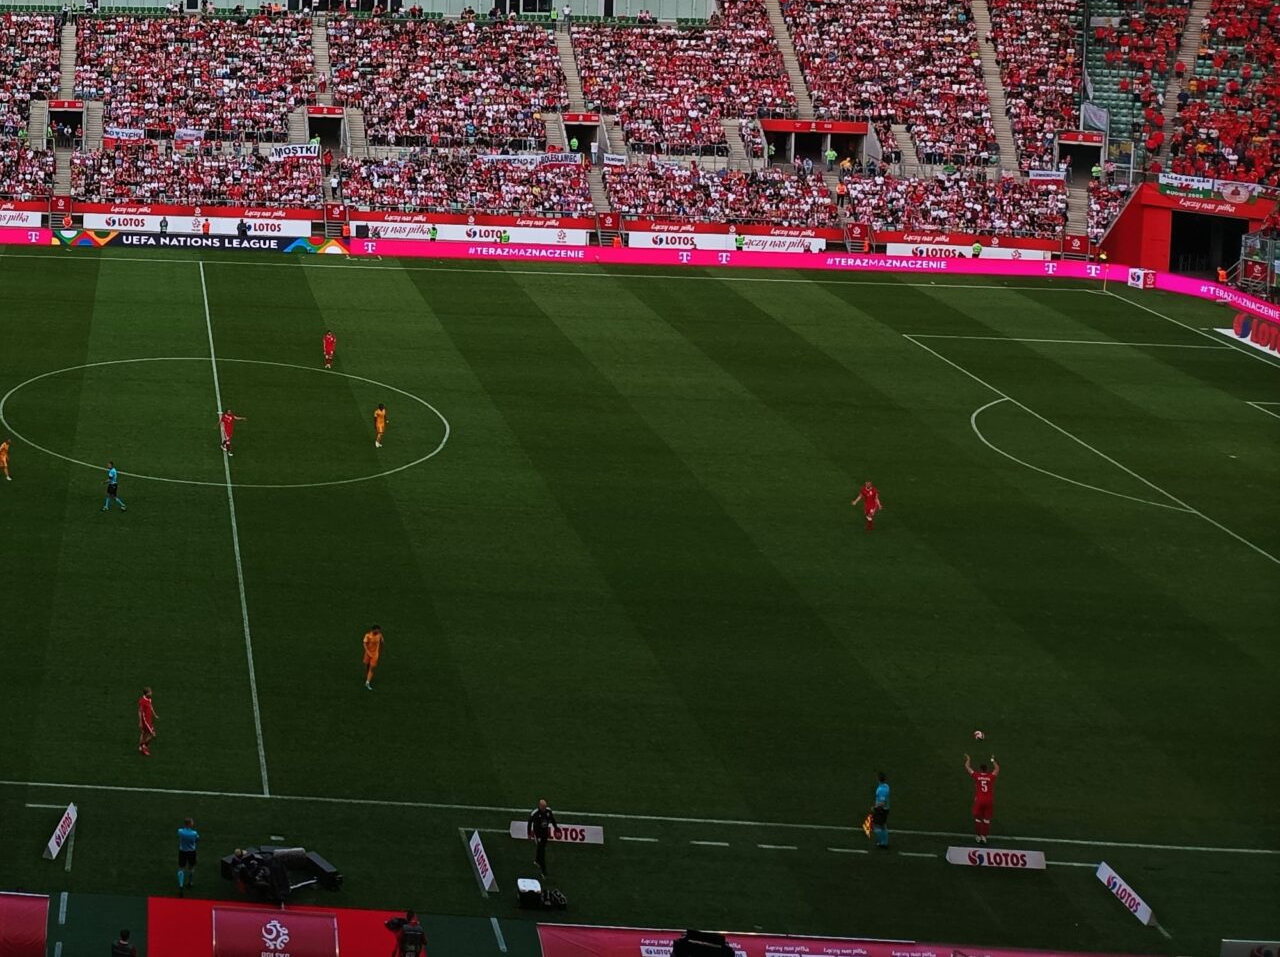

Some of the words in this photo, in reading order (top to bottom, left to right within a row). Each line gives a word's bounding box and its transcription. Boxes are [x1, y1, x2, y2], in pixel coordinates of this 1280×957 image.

[274, 145, 317, 158] MOSTKI
[1179, 198, 1200, 210] Łączy
[1201, 202, 1215, 210] nas
[1215, 202, 1235, 213] piłka
[7, 213, 29, 226] piłka
[117, 217, 145, 228] LOTOS
[253, 222, 282, 233] LOTOS
[406, 226, 430, 237] piłka
[479, 229, 504, 239] LOTO
[122, 235, 156, 245] UEFA
[160, 236, 220, 247] NATIONS
[225, 238, 278, 249] LEAGUE
[665, 236, 695, 246] LOTOS
[770, 239, 786, 247] nas
[785, 239, 812, 251] piłka
[468, 246, 585, 259] #TERAZMAZNACZENIE
[926, 247, 956, 258] LOTOS
[826, 257, 947, 270] #TERAZMAZNACZENIE
[1200, 285, 1280, 320] #TERAZMAZNACZENIE
[981, 780, 988, 793] 5
[59, 812, 73, 840] LOTOS
[548, 826, 586, 842] LOTOS
[476, 849, 490, 879] LOTOS
[987, 852, 1027, 867] LOTOS
[1115, 885, 1141, 914] LOTOS
